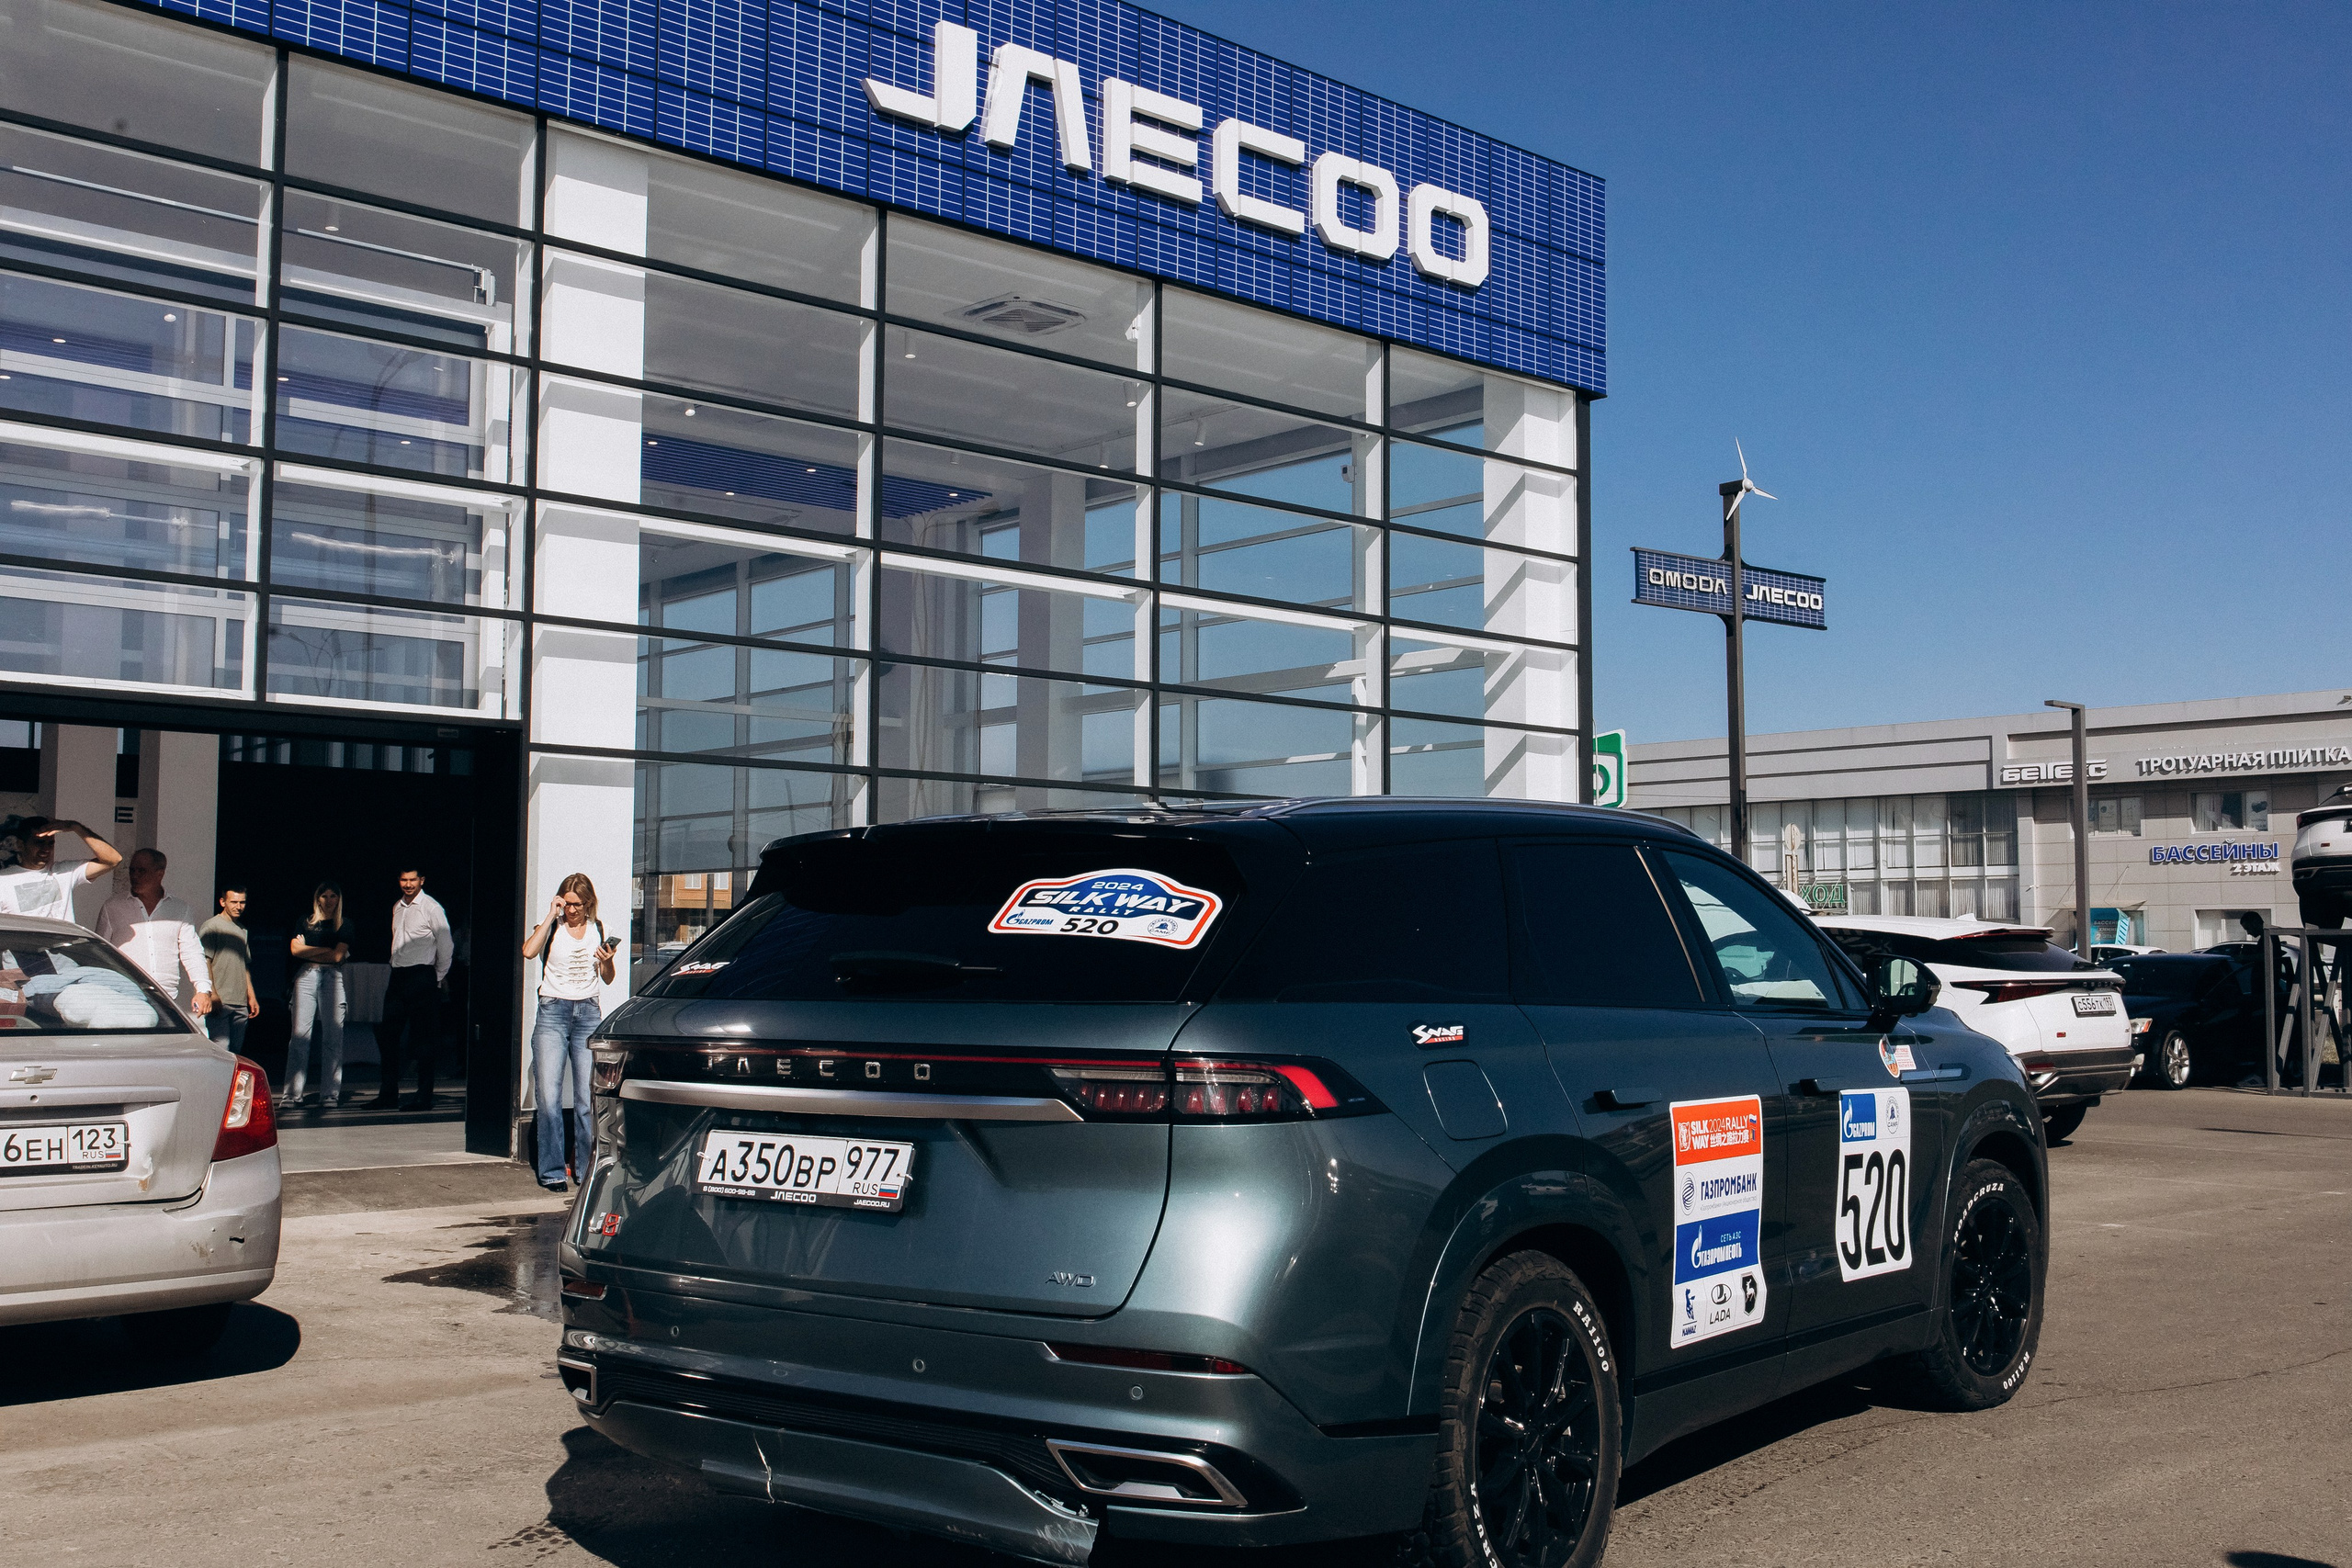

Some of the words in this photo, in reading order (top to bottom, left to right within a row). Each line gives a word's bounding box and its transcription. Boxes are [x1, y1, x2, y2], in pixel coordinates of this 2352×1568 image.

[861, 20, 1490, 288] JAECOO
[1649, 568, 1728, 595] OMODA
[1746, 584, 1823, 610] JAECOO
[2139, 750, 2267, 773] ТРОТУАРНАЯ
[2271, 746, 2352, 765] ПЛИТКА
[2152, 838, 2279, 863] БАССЕЙНЫ
[2233, 863, 2243, 873] 2
[2243, 863, 2280, 873] ЭТАЖ
[1091, 881, 1144, 892] 2024
[1798, 885, 1846, 908] ХОД
[1026, 890, 1113, 906] SILK
[1114, 893, 1196, 913] WAY
[1069, 906, 1136, 916] RALLY
[1059, 918, 1119, 935] 520
[1690, 1120, 1709, 1135] SILK
[1709, 1118, 1725, 1133] 2024
[1725, 1115, 1748, 1131] RALLY
[73, 1128, 116, 1150] 123
[1691, 1134, 1709, 1150] WAY
[82, 1151, 105, 1159] RUS
[708, 1140, 836, 1190] А350ВР
[846, 1146, 899, 1182] 977
[770, 1190, 817, 1203] JAECOO
[853, 1182, 878, 1195] RUS
[1701, 1172, 1758, 1201] ГАЗПРОМБАНК
[854, 1199, 890, 1208] JAECOO.RU
[1839, 1148, 1906, 1270] 520
[1953, 1182, 2005, 1241] ROADCRUZA
[1721, 1234, 1732, 1243] СЕТЬ
[1732, 1231, 1742, 1240] АЗС
[1045, 1271, 1096, 1287] AWD
[1710, 1308, 1731, 1325] LADA
[1572, 1301, 1609, 1372] RA1100
